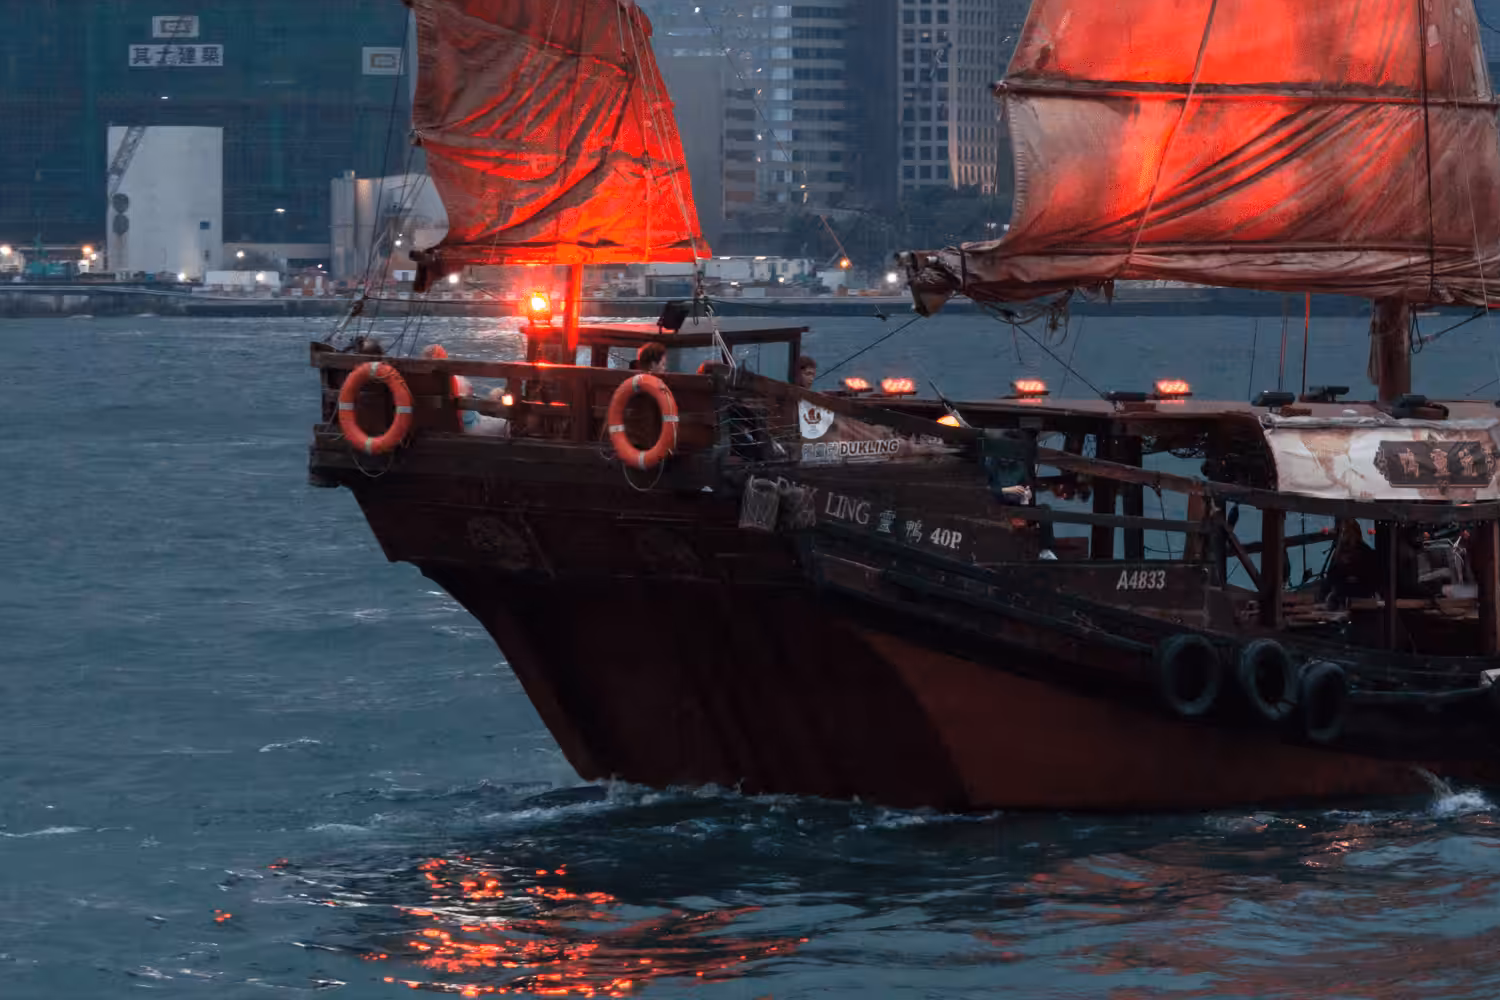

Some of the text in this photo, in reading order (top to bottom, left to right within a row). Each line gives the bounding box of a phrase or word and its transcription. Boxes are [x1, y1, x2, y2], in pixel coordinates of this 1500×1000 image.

[839, 438, 900, 457] DUKLING
[824, 492, 871, 525] LING
[1116, 570, 1166, 590] A4833
